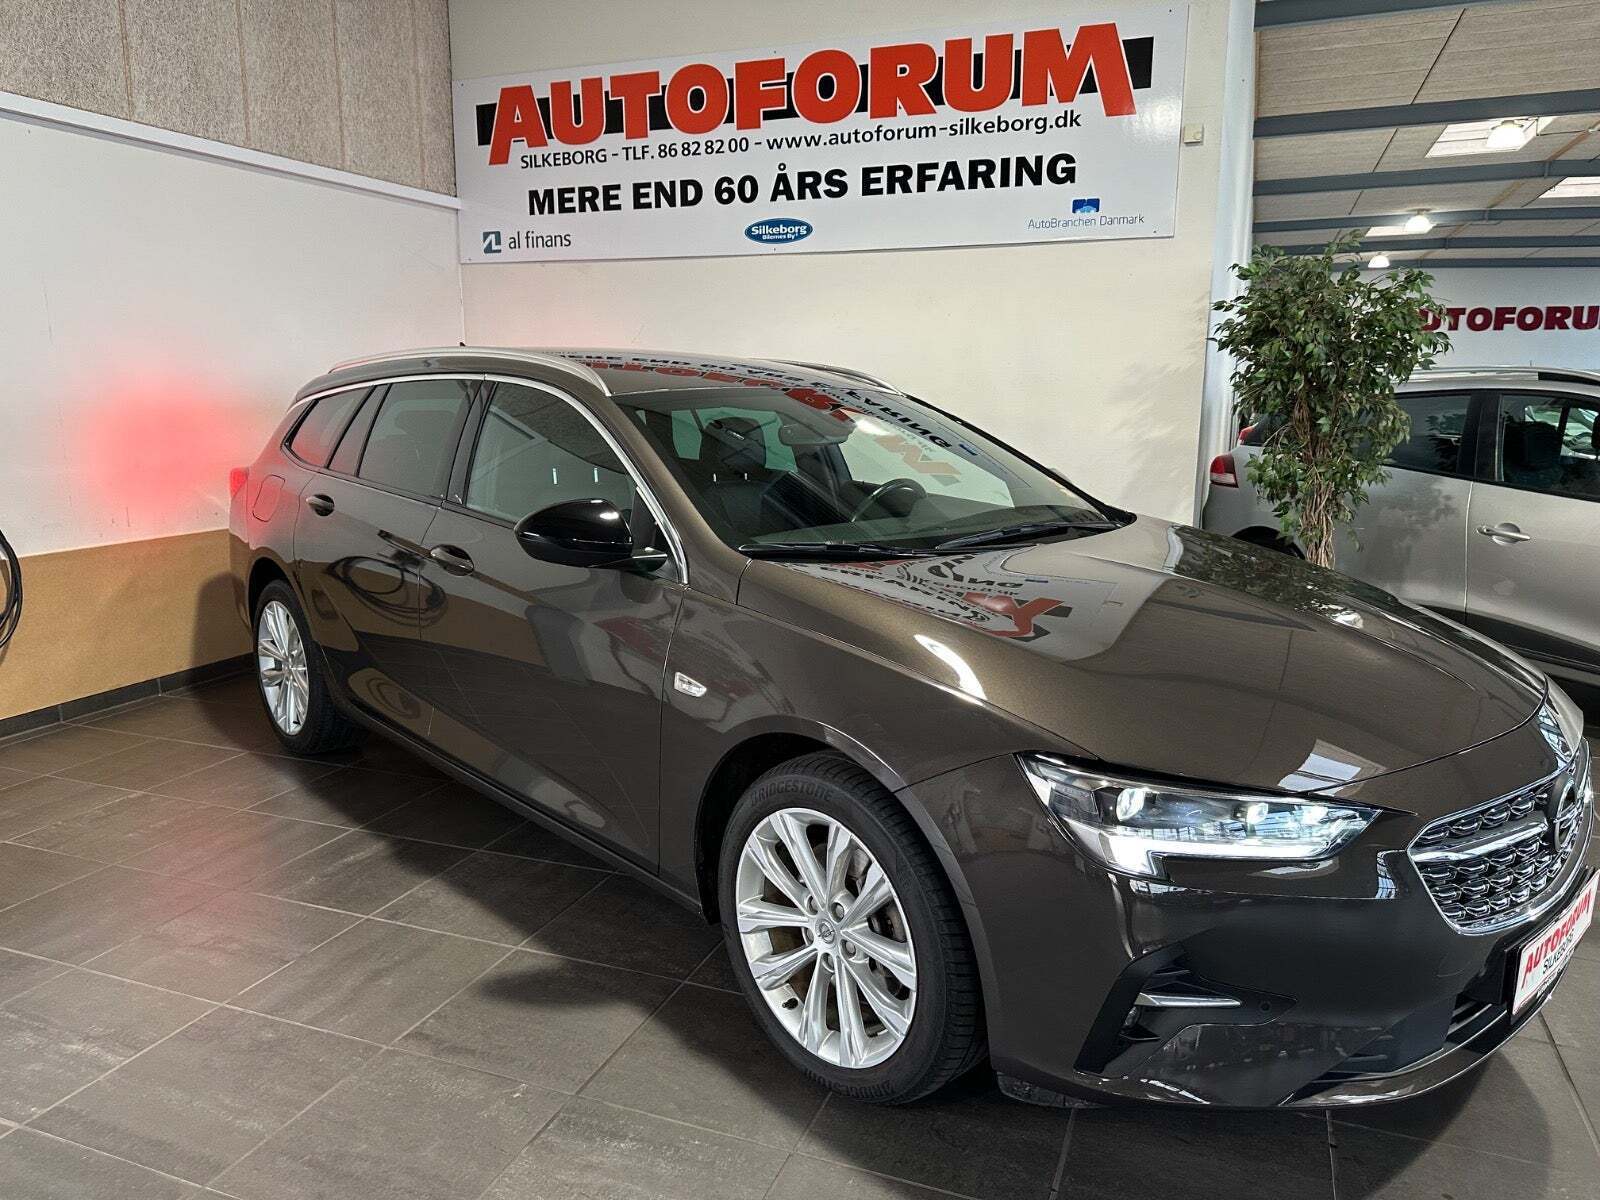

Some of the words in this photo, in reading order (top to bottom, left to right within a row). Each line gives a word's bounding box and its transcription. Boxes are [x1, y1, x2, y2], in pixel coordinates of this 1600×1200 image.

[488, 22, 1137, 166] AUTOFORUM
[520, 149, 607, 169] SILKEBORG
[622, 145, 655, 161] TLF.
[766, 109, 1082, 150] www.autoforum-silkeborg.dk
[528, 183, 622, 216] MERE
[632, 179, 703, 210] END
[714, 175, 759, 206] 60
[770, 162, 849, 202] ÅRS
[861, 153, 1077, 197] ERFARING
[751, 224, 808, 235] Silkeborg
[1028, 217, 1096, 230] AutoBranchen
[1099, 213, 1145, 226] Danmark
[508, 231, 521, 250] al
[525, 230, 572, 249] finans
[1418, 305, 1600, 331] UTOFORU
